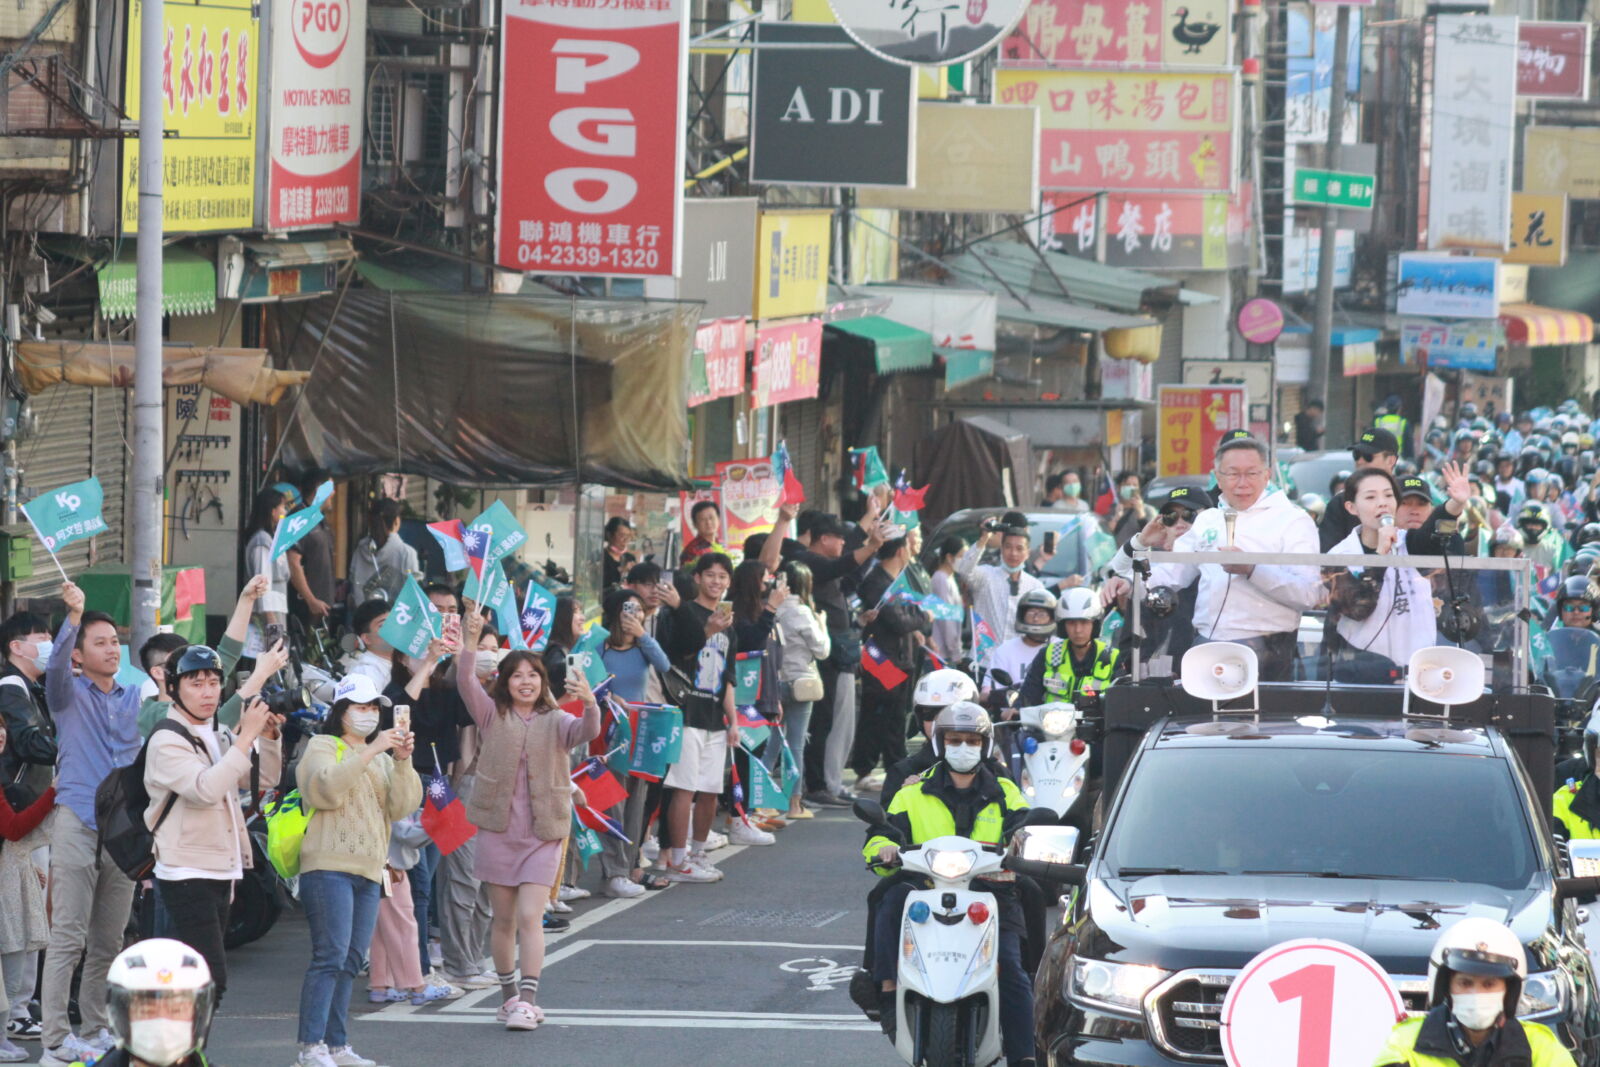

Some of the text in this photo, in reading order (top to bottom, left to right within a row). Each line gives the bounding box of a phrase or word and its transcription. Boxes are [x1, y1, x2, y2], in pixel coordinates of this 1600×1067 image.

[302, 2, 341, 32] PGO
[283, 88, 350, 106] MOTIVE POWER
[780, 86, 883, 125] ADI
[281, 123, 350, 156] 摩特動力機車
[544, 38, 640, 214] PGO
[519, 220, 661, 247] 聯鴻機車行
[517, 244, 659, 268] 04-2339-1320
[1171, 488, 1188, 498] SSC
[1269, 964, 1336, 1067] 1
